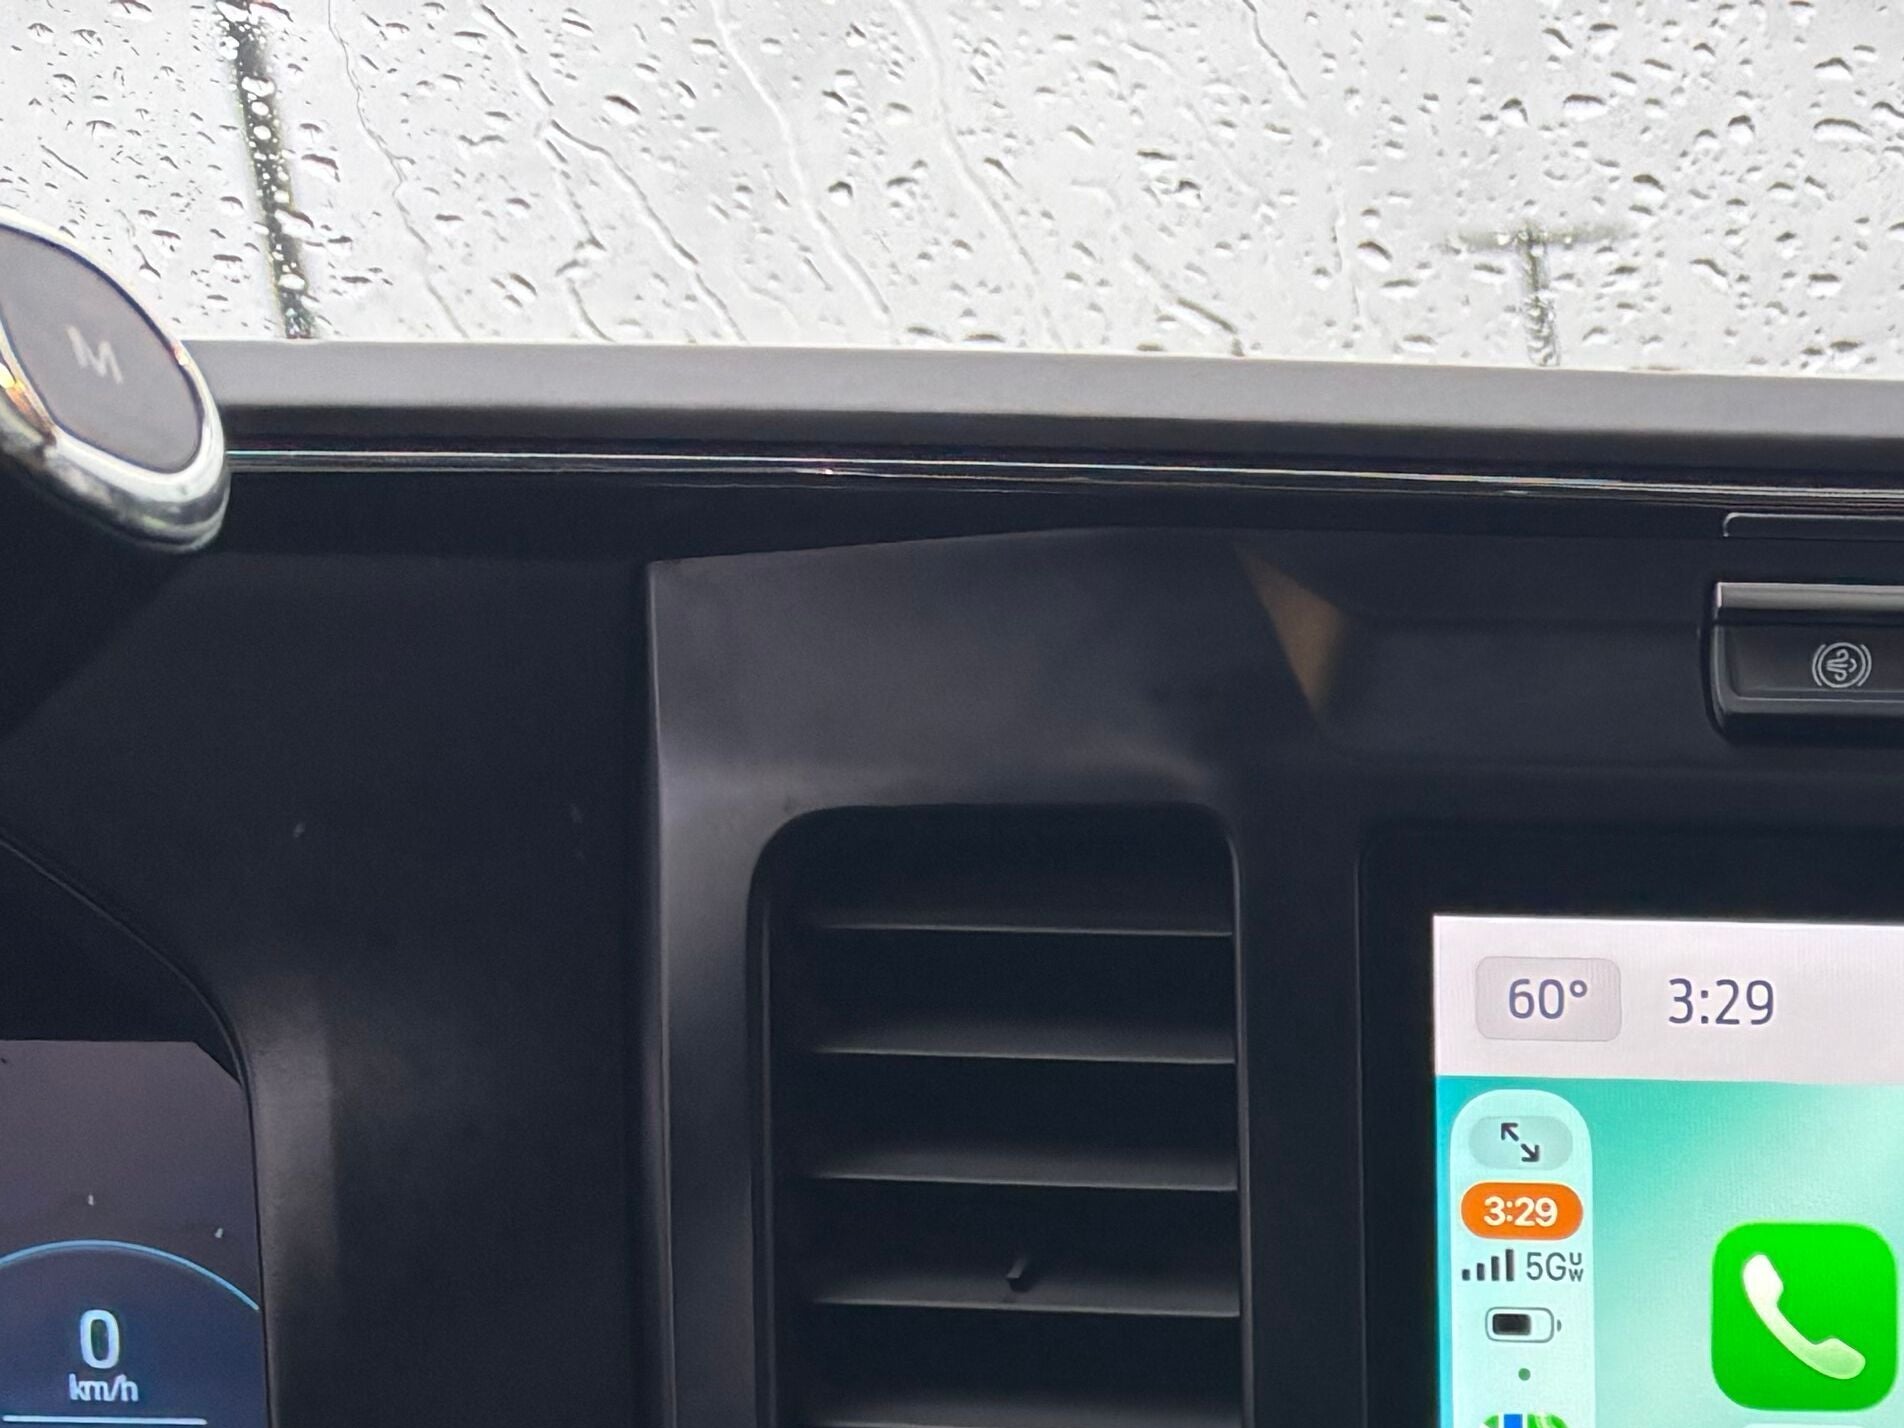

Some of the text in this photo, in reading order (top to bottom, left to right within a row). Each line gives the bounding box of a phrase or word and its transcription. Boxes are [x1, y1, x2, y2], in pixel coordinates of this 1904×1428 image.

[1508, 977, 1588, 1020] 60°
[1667, 978, 1776, 1025] 3:29
[1483, 1195, 1559, 1227] 3:29
[80, 1309, 120, 1369] 0
[69, 1373, 139, 1402] km/h
